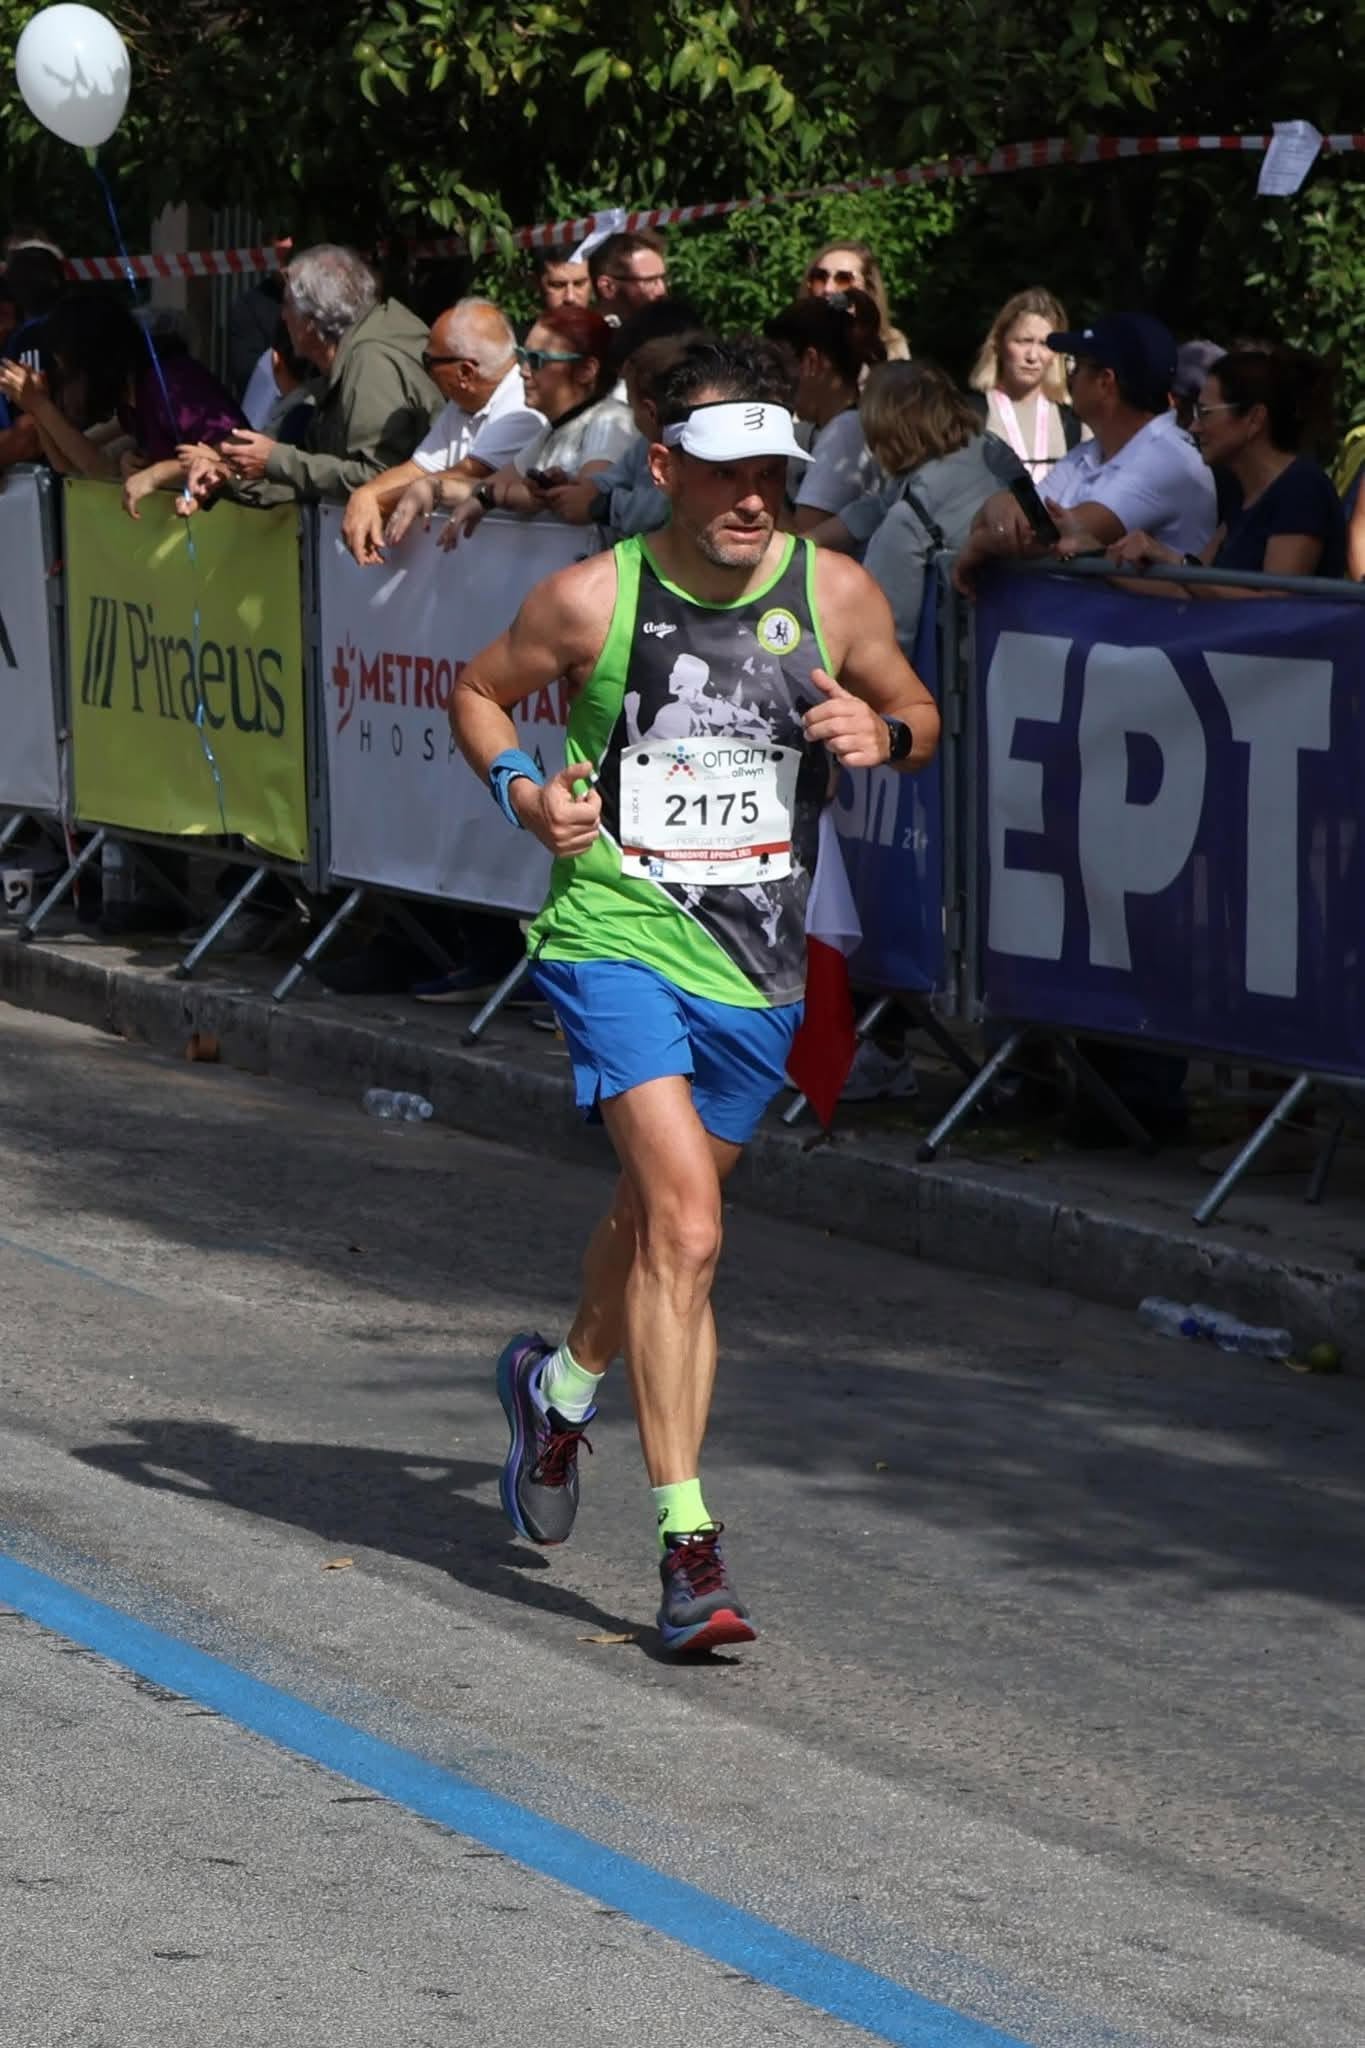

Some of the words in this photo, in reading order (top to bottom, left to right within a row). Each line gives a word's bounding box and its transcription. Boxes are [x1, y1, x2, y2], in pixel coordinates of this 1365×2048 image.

[123, 601, 285, 738] Piraeus
[731, 767, 764, 779] allwyn
[665, 790, 759, 826] 2175
